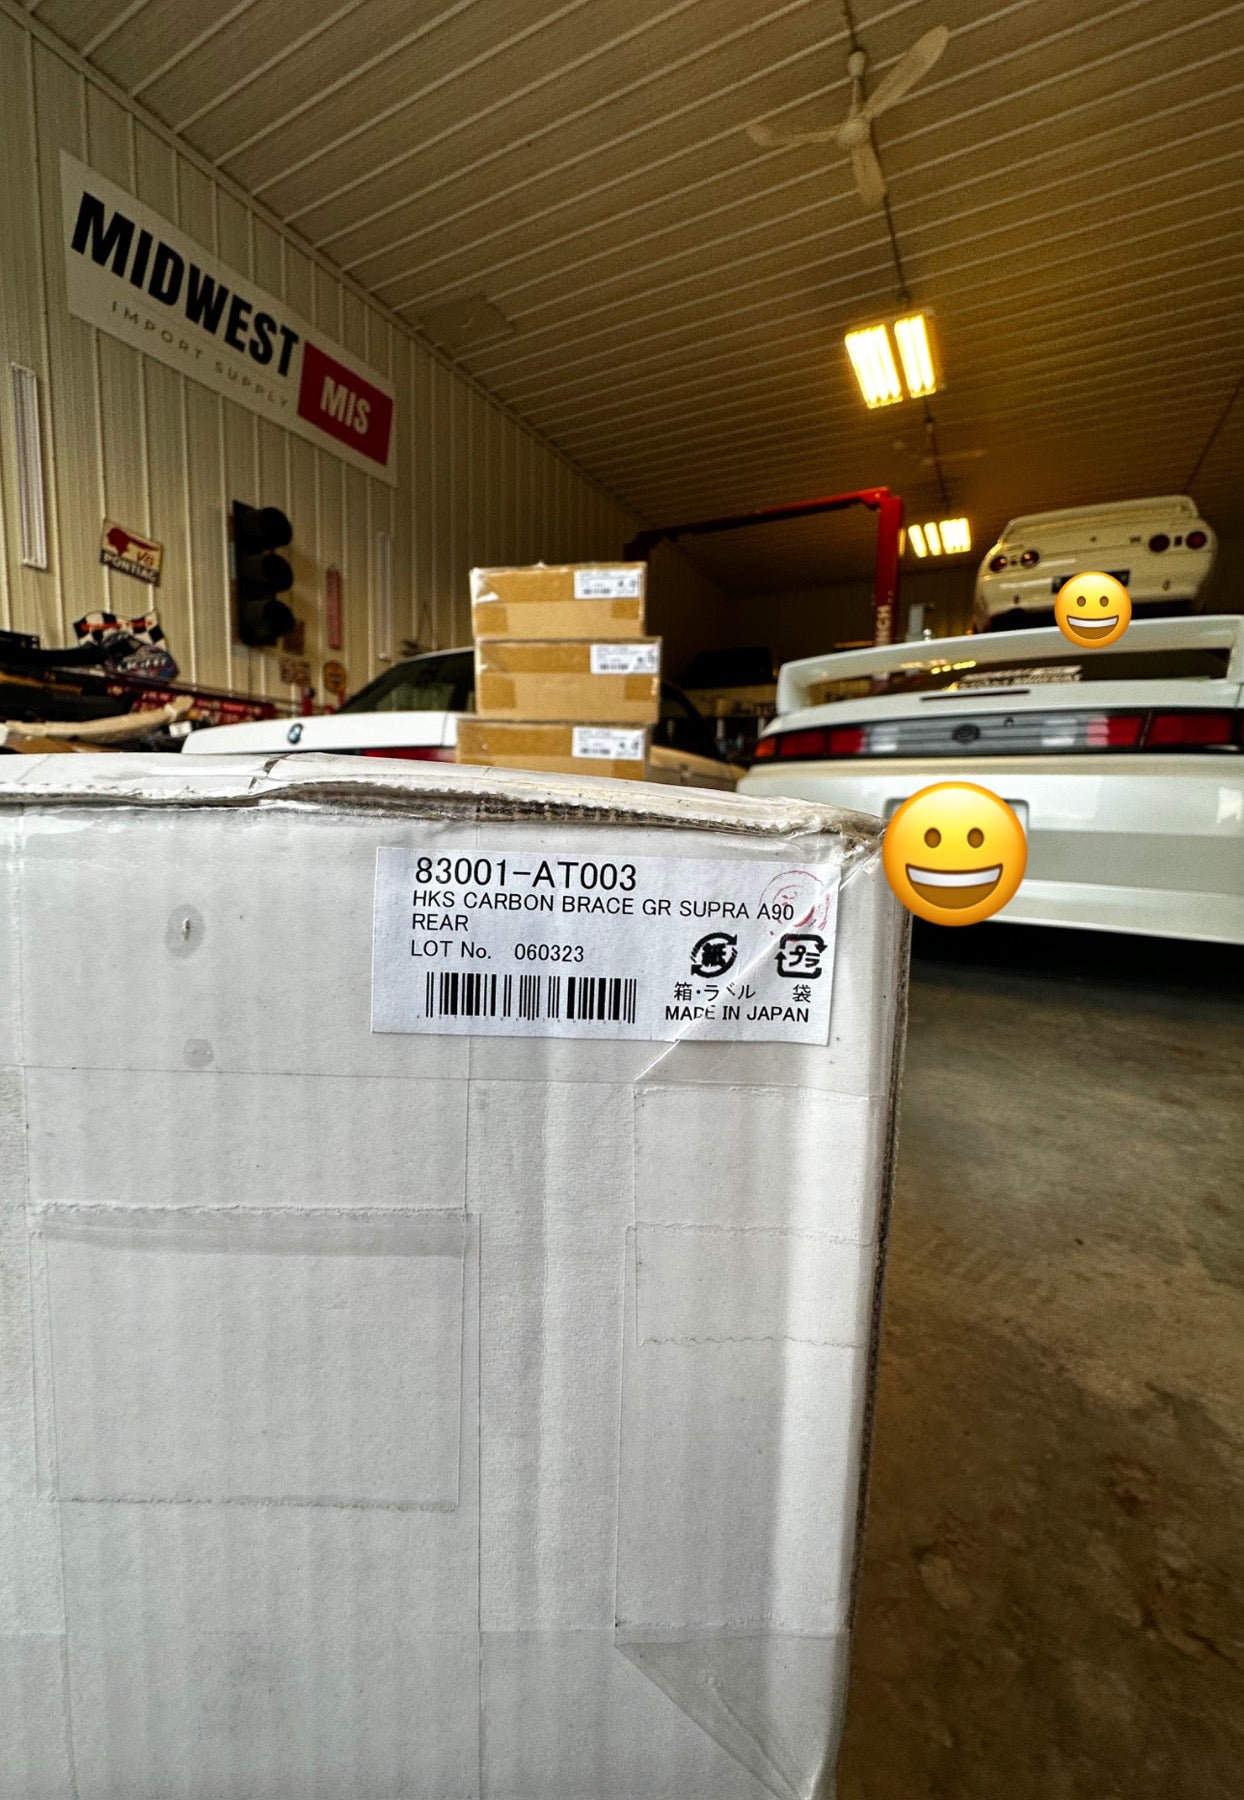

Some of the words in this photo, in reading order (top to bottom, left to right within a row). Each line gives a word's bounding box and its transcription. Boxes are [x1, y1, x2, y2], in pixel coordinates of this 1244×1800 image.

[71, 191, 299, 377] MIDWEST
[112, 301, 202, 360] IMPORT
[215, 361, 288, 408] SUPPLY
[320, 375, 371, 434] MIS
[104, 554, 156, 582] PONTIAC
[416, 857, 636, 890] 83001-AT003
[413, 890, 454, 908] HKS
[464, 892, 554, 912] CARBON
[563, 896, 634, 915] BRACE
[643, 899, 671, 916] GR
[680, 901, 749, 919] SUPRA
[757, 903, 794, 921] A90
[413, 914, 468, 932] REAR
[411, 940, 453, 957] LOT
[461, 941, 492, 960] No.
[515, 944, 584, 963] 060323
[792, 985, 812, 1003] 袋
[665, 1005, 716, 1021] MADE
[723, 1005, 741, 1021] IN
[747, 1006, 809, 1024] JAPAN
